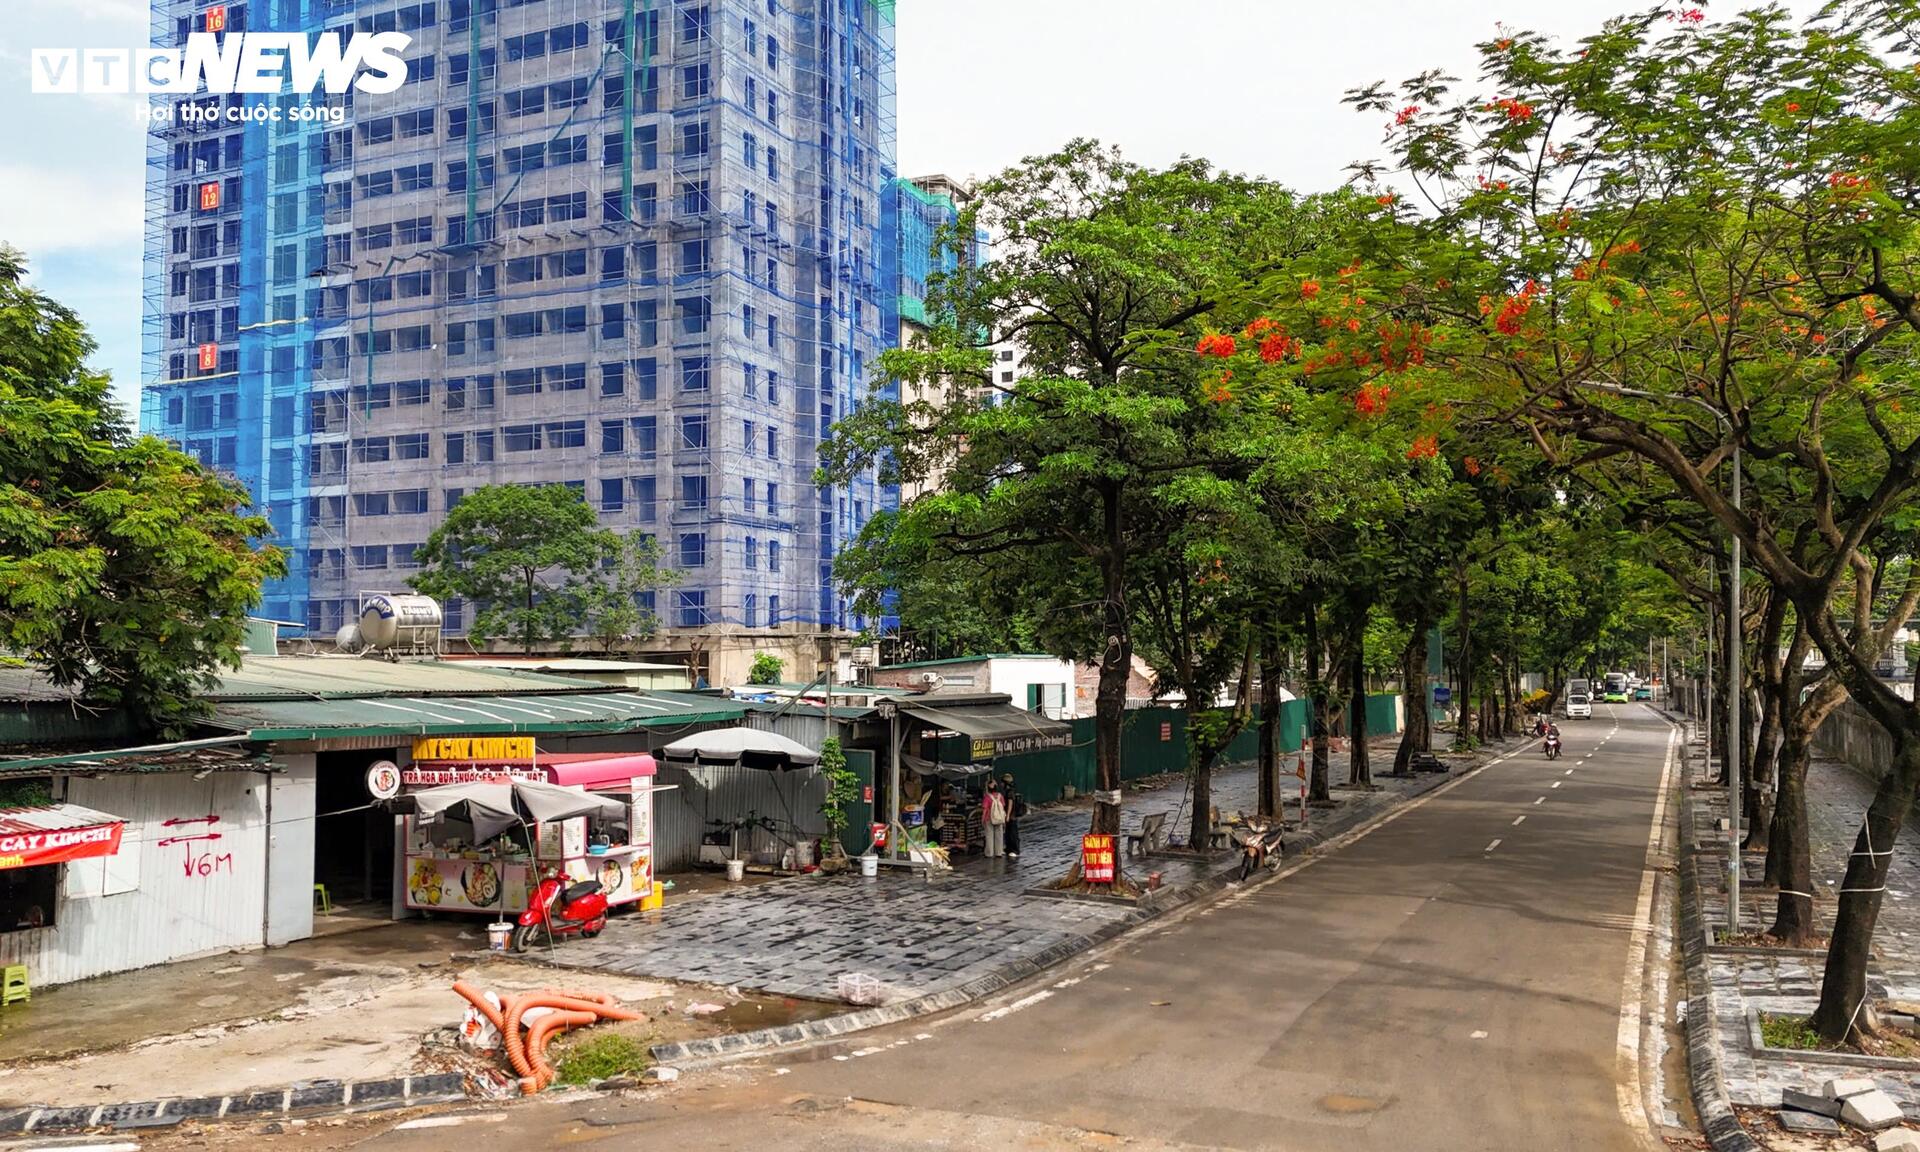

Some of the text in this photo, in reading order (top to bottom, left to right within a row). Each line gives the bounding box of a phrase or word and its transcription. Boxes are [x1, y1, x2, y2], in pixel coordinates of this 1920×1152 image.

[209, 15, 222, 29] 16
[204, 192, 217, 207] 12
[204, 353, 212, 367] 8
[1, 836, 42, 852] CAY
